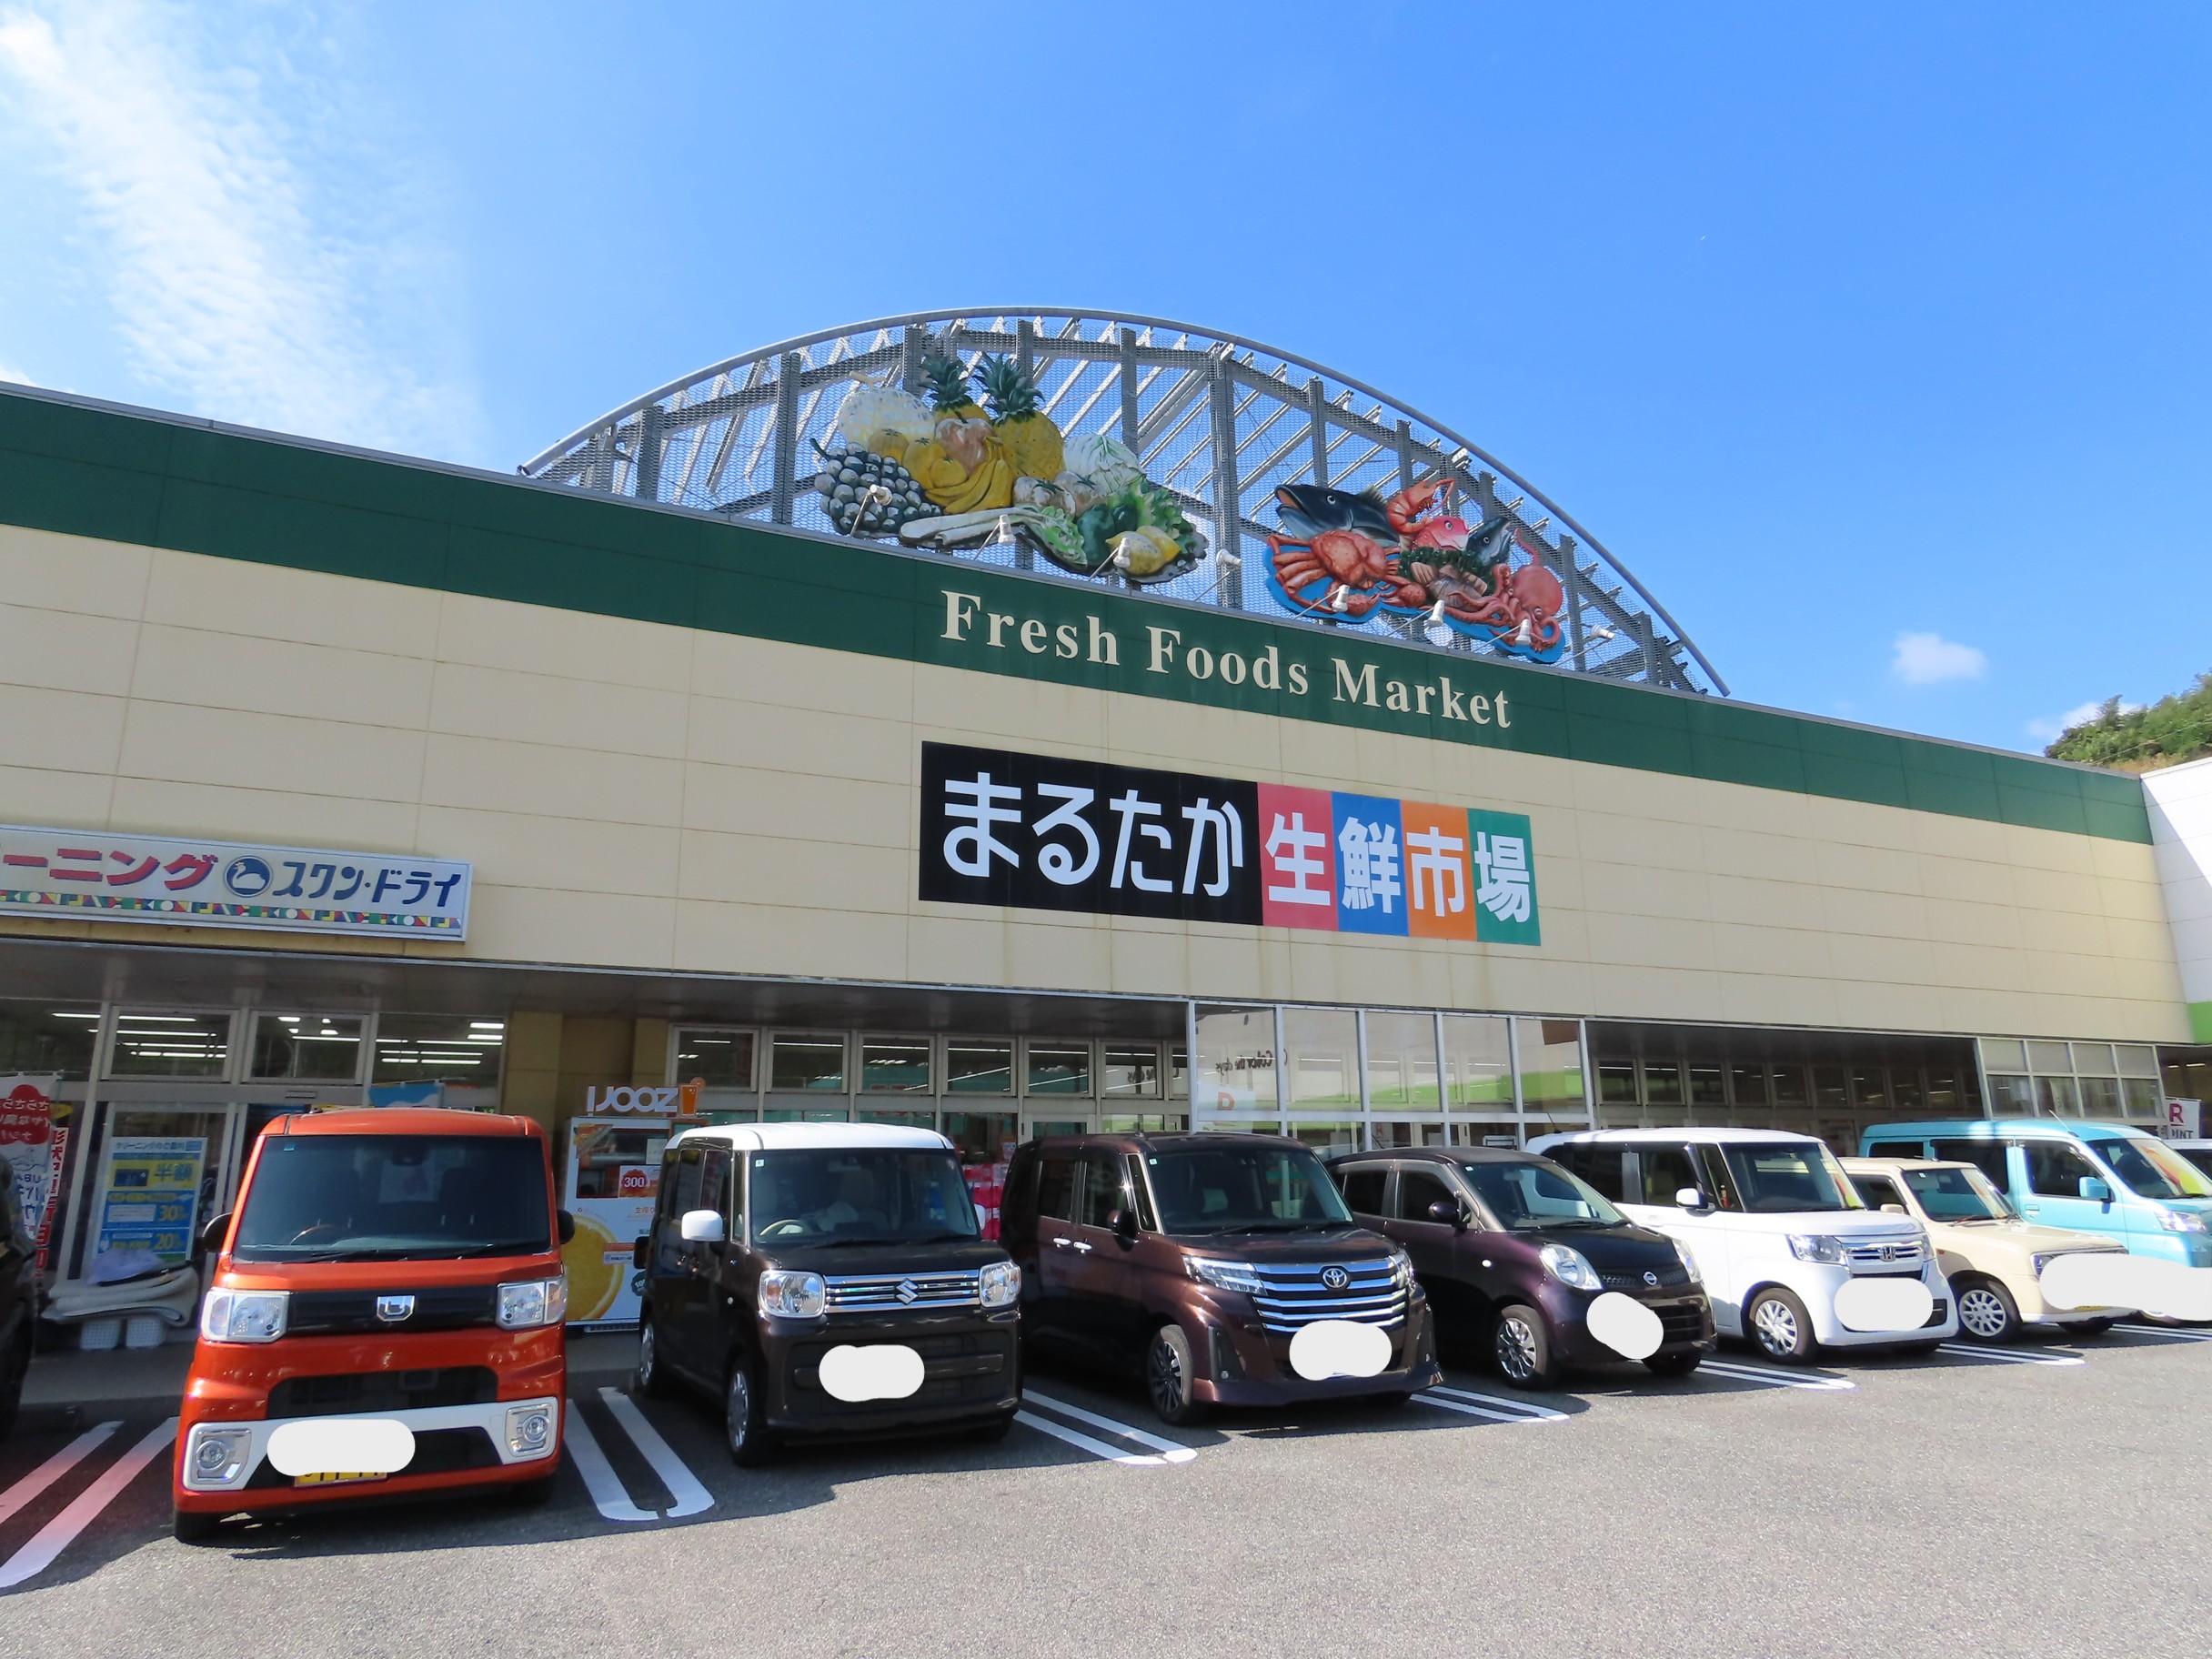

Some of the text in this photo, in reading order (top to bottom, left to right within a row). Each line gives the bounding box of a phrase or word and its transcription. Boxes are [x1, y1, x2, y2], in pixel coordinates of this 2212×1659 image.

[940, 589, 1512, 729] Fresh Foods Market
[0, 843, 219, 891] ーニング
[2169, 1103, 2185, 1123] R
[624, 1176, 645, 1188] 300
